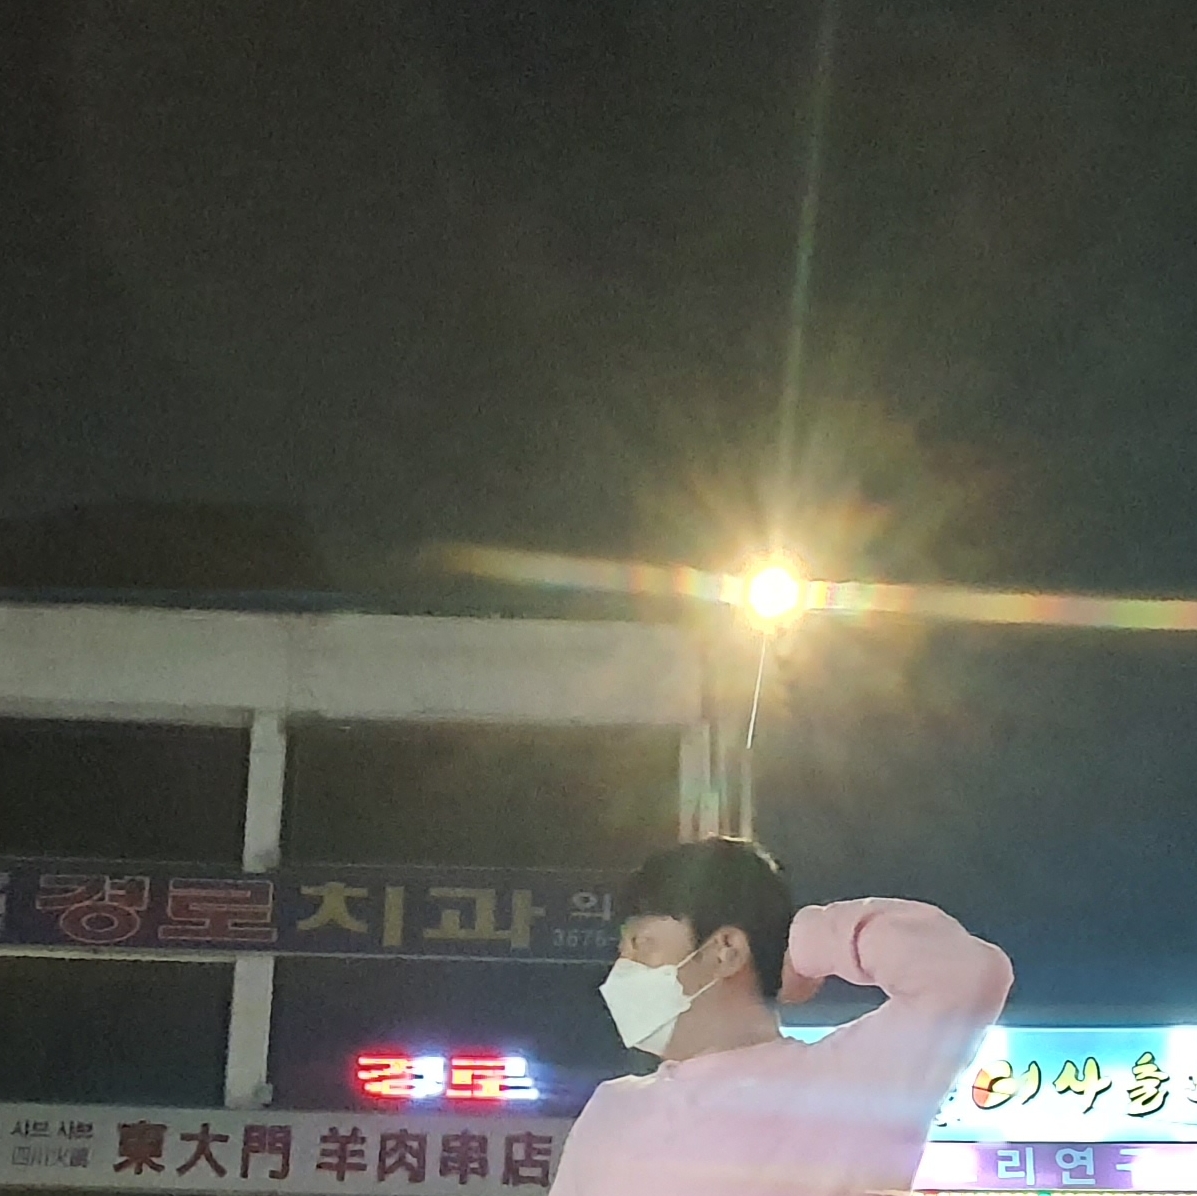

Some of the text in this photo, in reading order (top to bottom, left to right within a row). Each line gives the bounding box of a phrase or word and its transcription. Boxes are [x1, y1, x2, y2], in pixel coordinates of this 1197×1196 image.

[296, 881, 546, 950] 치과
[112, 1119, 553, 1188] 東大門 羊肉串店
